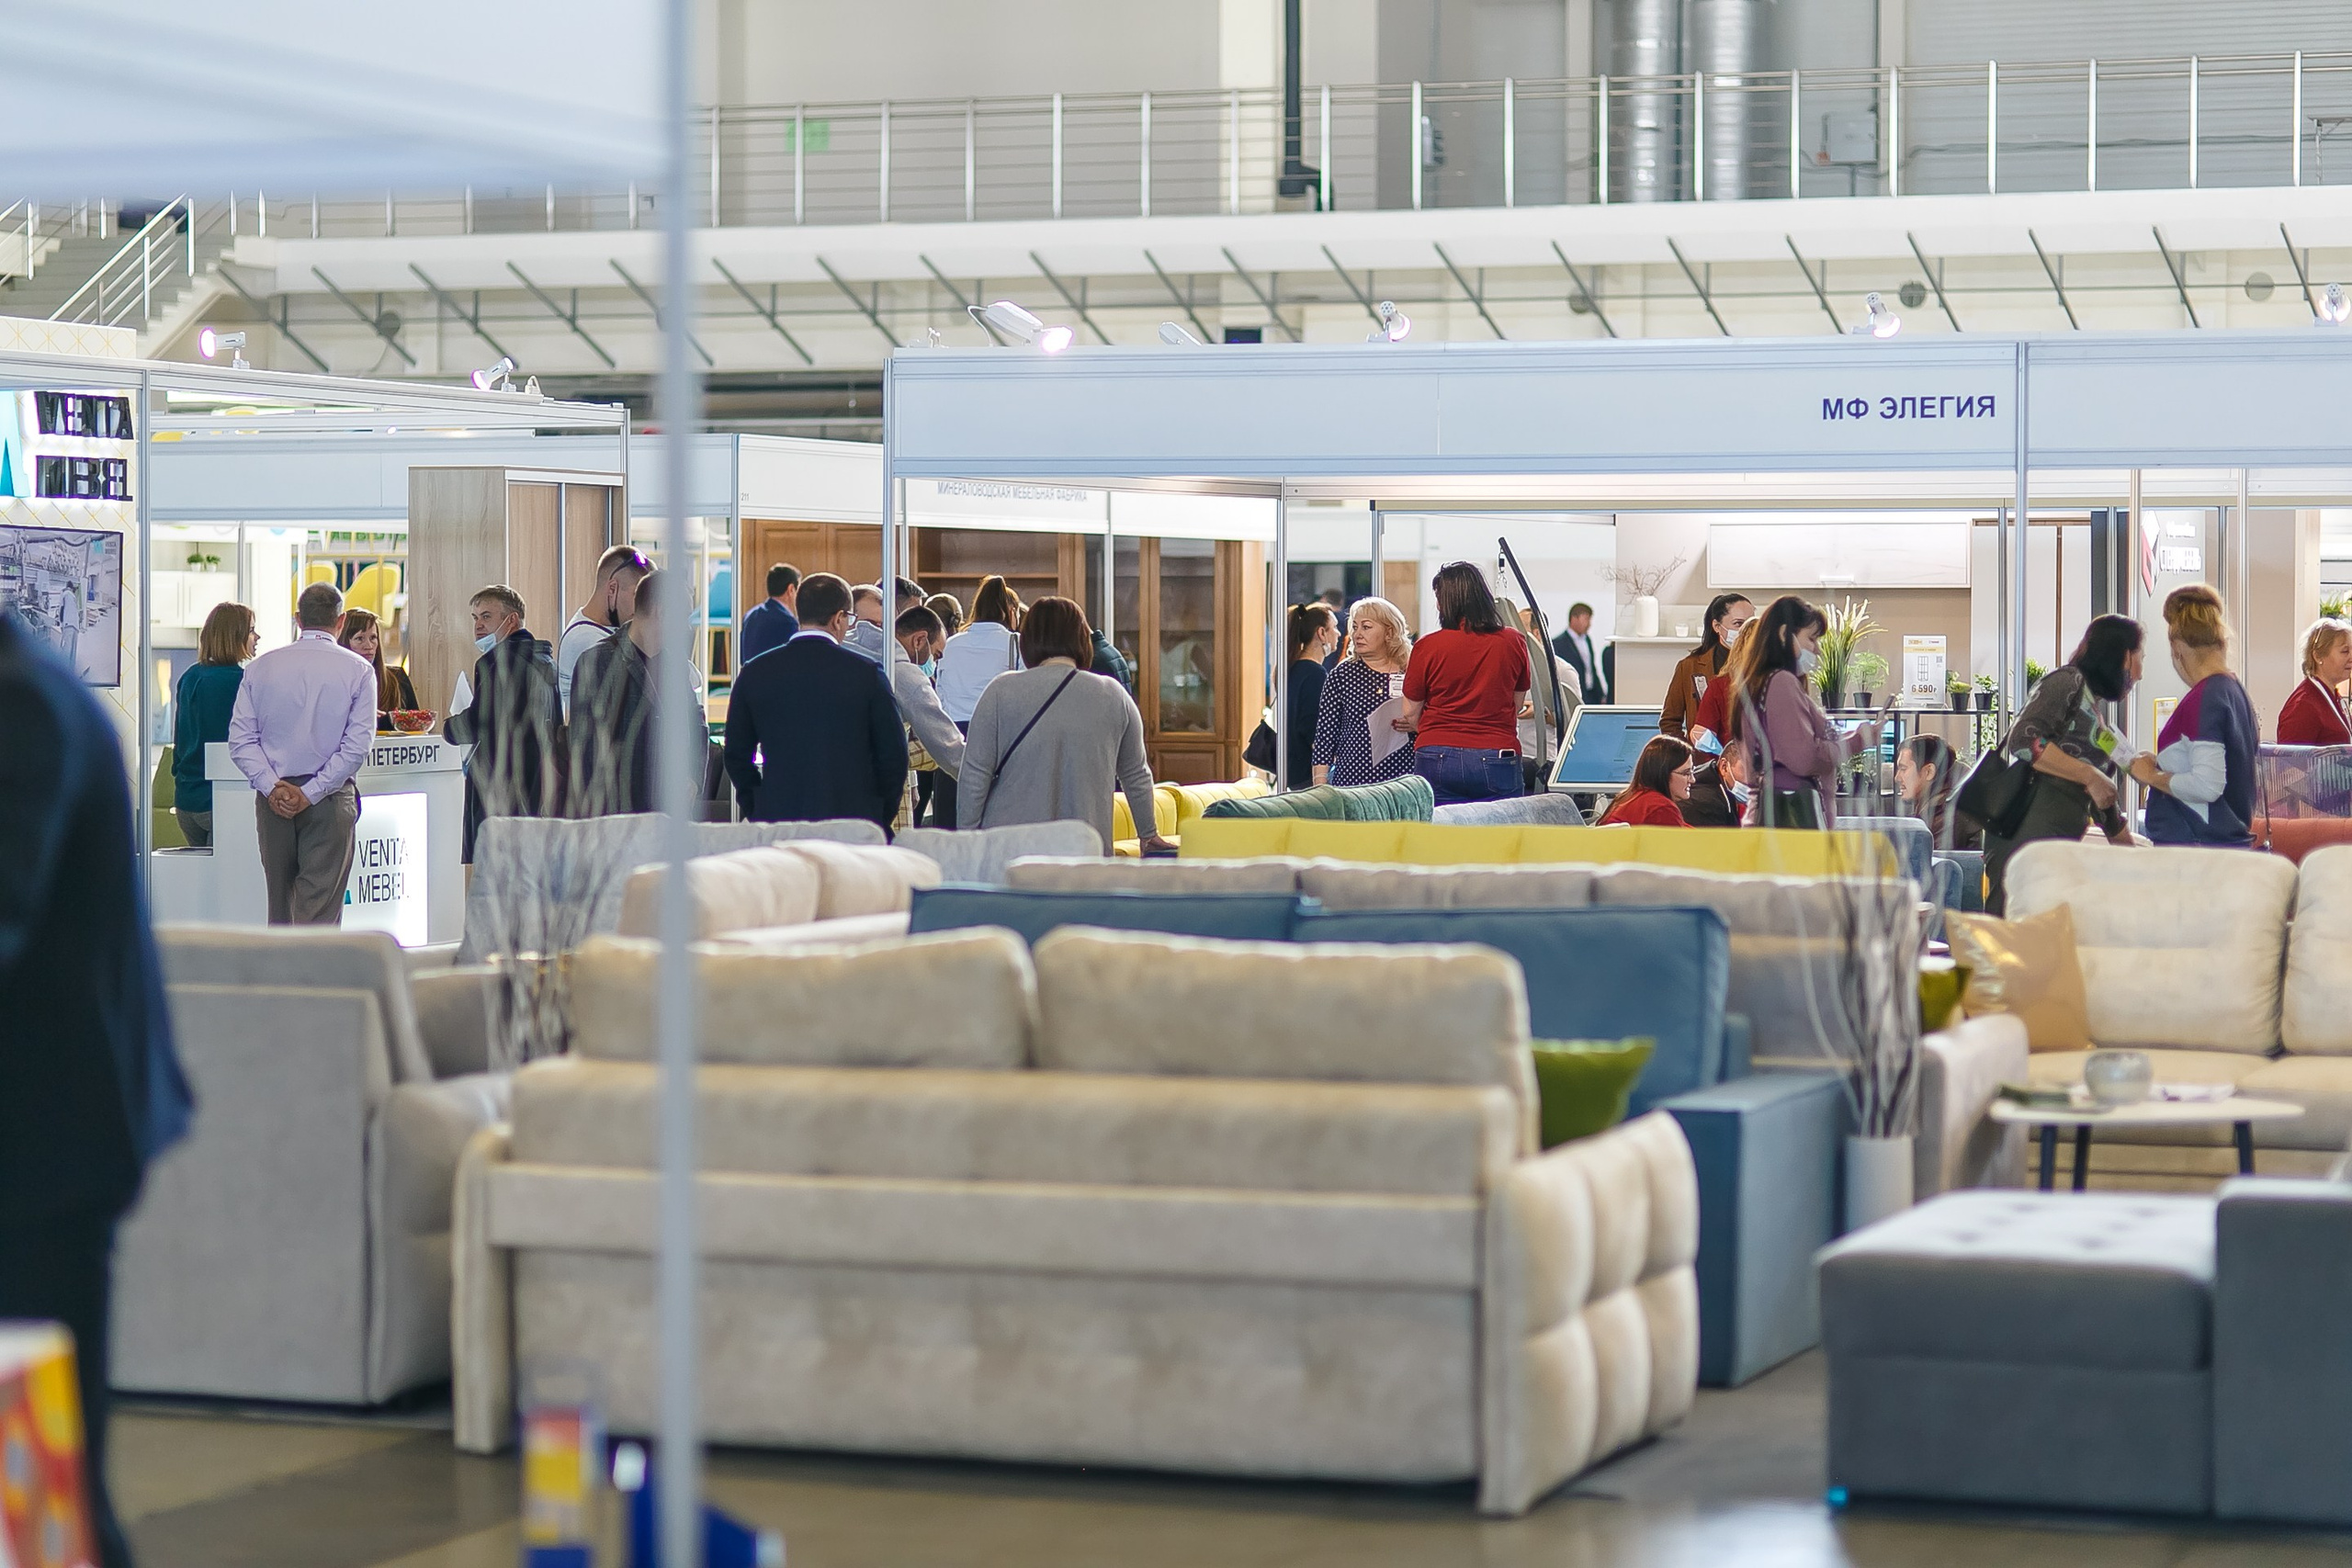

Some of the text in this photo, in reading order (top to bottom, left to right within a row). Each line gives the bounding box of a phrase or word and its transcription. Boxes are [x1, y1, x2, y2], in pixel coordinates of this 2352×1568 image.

[34, 390, 134, 439] VENTA
[1823, 395, 1996, 420] МФ ЭЛЕГИЯ
[35, 455, 133, 502] MEBEL
[937, 481, 1088, 502] МИНЕРАЛОВОДСКАЯ МЕБЕЛЬНАЯ ФАБРИКА
[358, 837, 410, 868] VENTA
[358, 872, 410, 904] MEBEL
